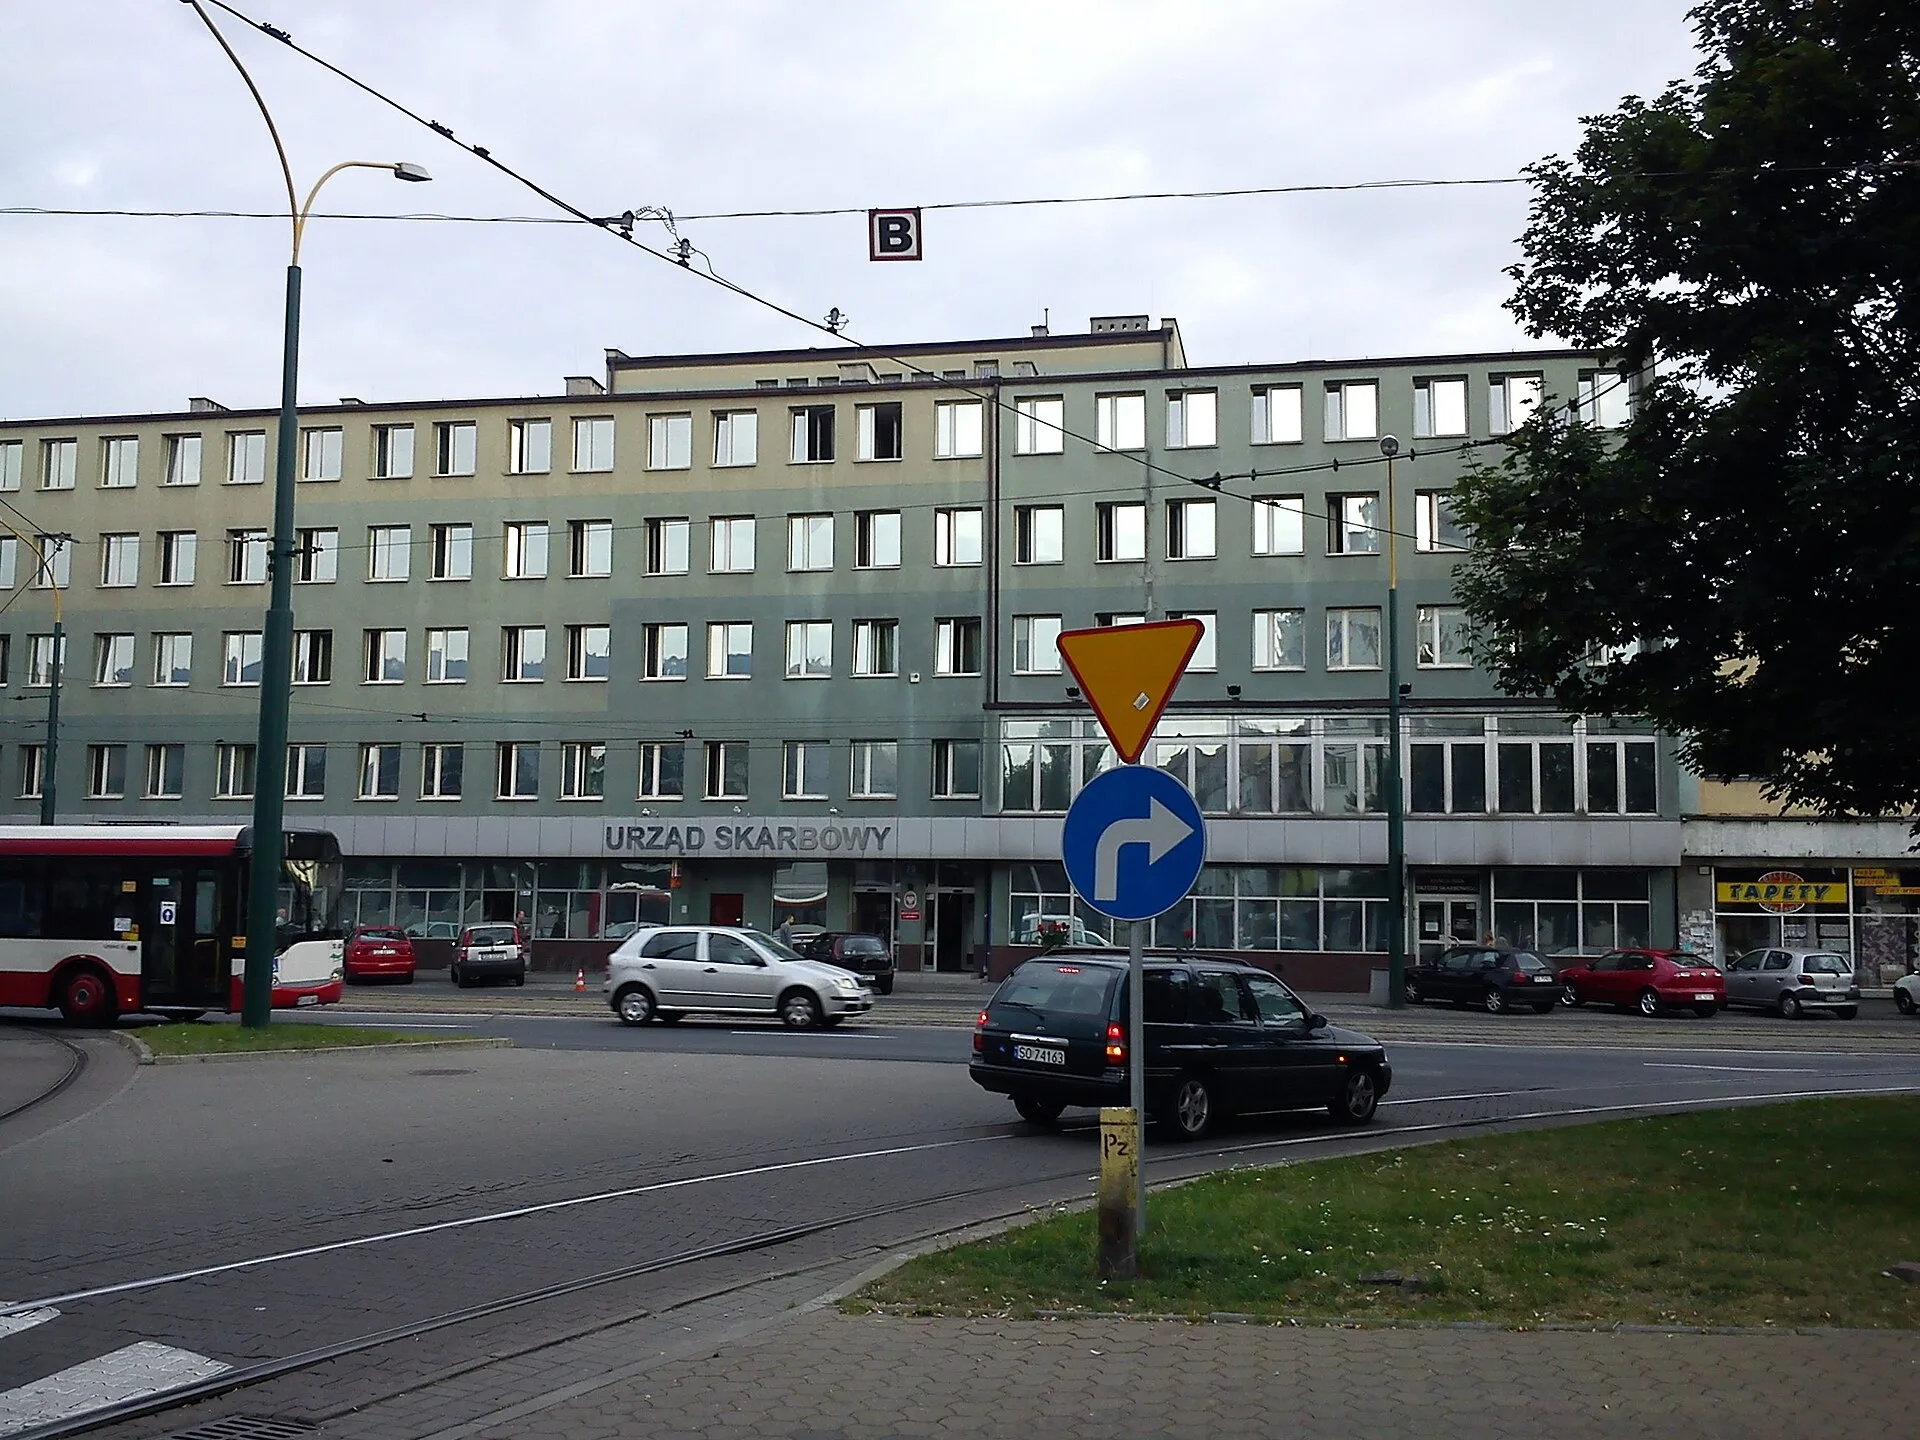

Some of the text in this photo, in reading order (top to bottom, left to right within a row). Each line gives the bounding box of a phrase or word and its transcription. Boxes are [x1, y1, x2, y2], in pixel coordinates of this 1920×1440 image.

[879, 216, 913, 253] B
[606, 826, 891, 856] URZĄD SKARBOWY
[1730, 884, 1831, 900] TAPETY
[1034, 1048, 1064, 1065] 74163
